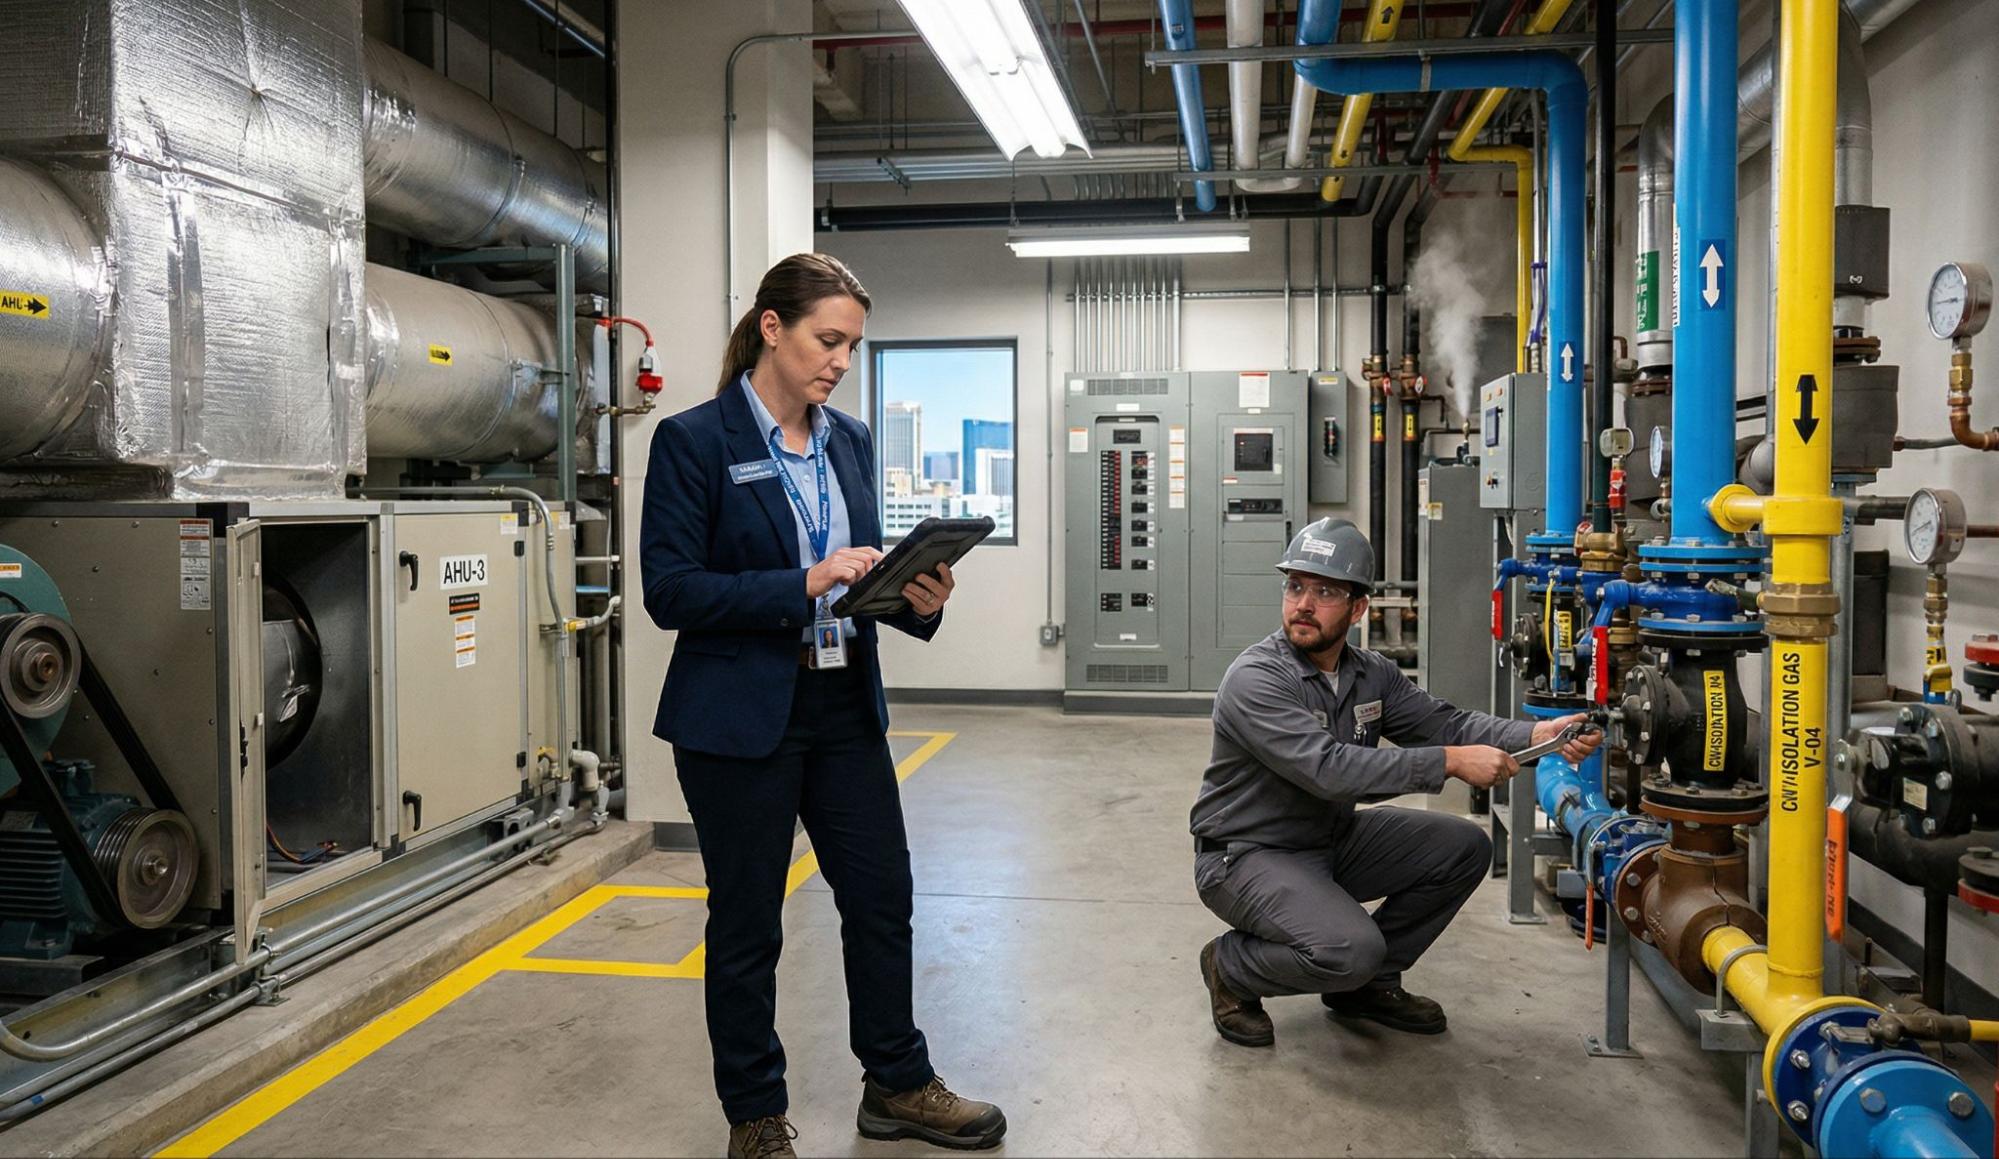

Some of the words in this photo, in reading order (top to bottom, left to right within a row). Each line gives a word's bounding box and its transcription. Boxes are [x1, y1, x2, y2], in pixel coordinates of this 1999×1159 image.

[443, 559, 485, 584] AHU-3
[1782, 653, 1801, 685] GAS
[1804, 727, 1822, 769] V-04
